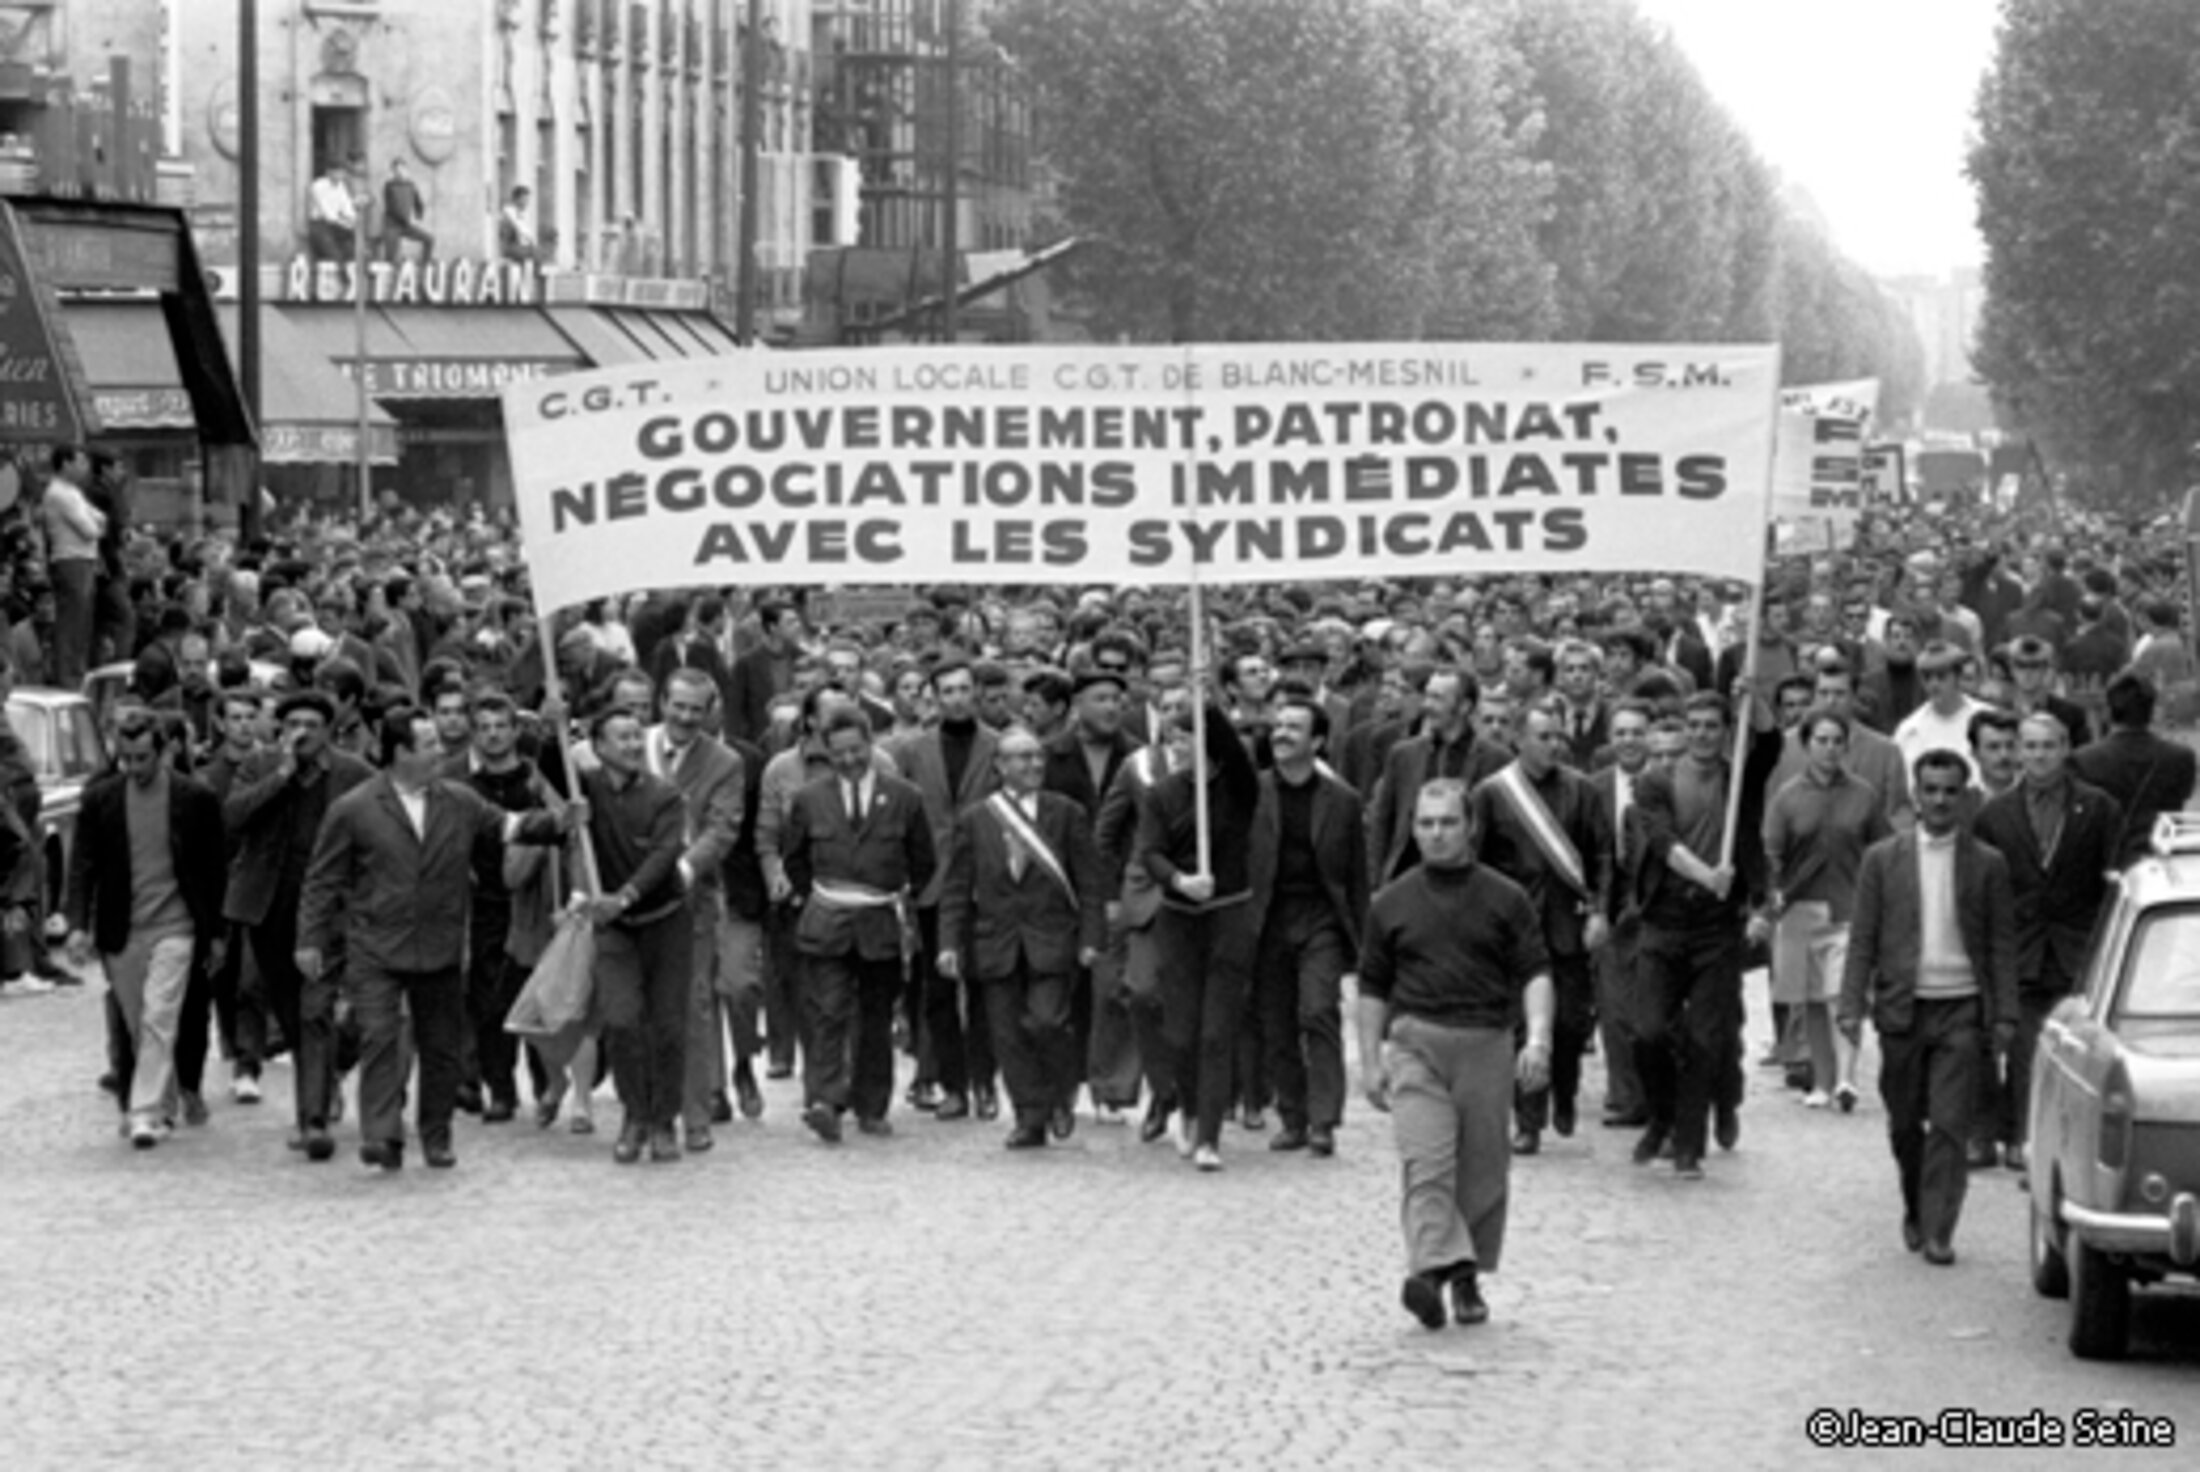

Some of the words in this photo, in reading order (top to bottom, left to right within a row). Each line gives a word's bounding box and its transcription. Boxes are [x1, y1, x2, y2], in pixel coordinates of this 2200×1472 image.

[287, 253, 559, 304] RESTAURANT
[538, 380, 672, 421] C.G.T.
[764, 366, 878, 395] UNION
[893, 363, 1030, 392] LOCALE
[1053, 362, 1148, 391] C.G.T.
[1163, 362, 1202, 391] DE
[1221, 359, 1480, 388] BLANC-MESNIL
[1581, 361, 1733, 389] F.S.M.
[551, 458, 1137, 532] NÉGOCIATIONS
[1172, 450, 1728, 508] IMMÉDIATES
[693, 519, 905, 565] AVEC
[952, 519, 1089, 564] LES
[1128, 508, 1588, 565] SYNDICATS
